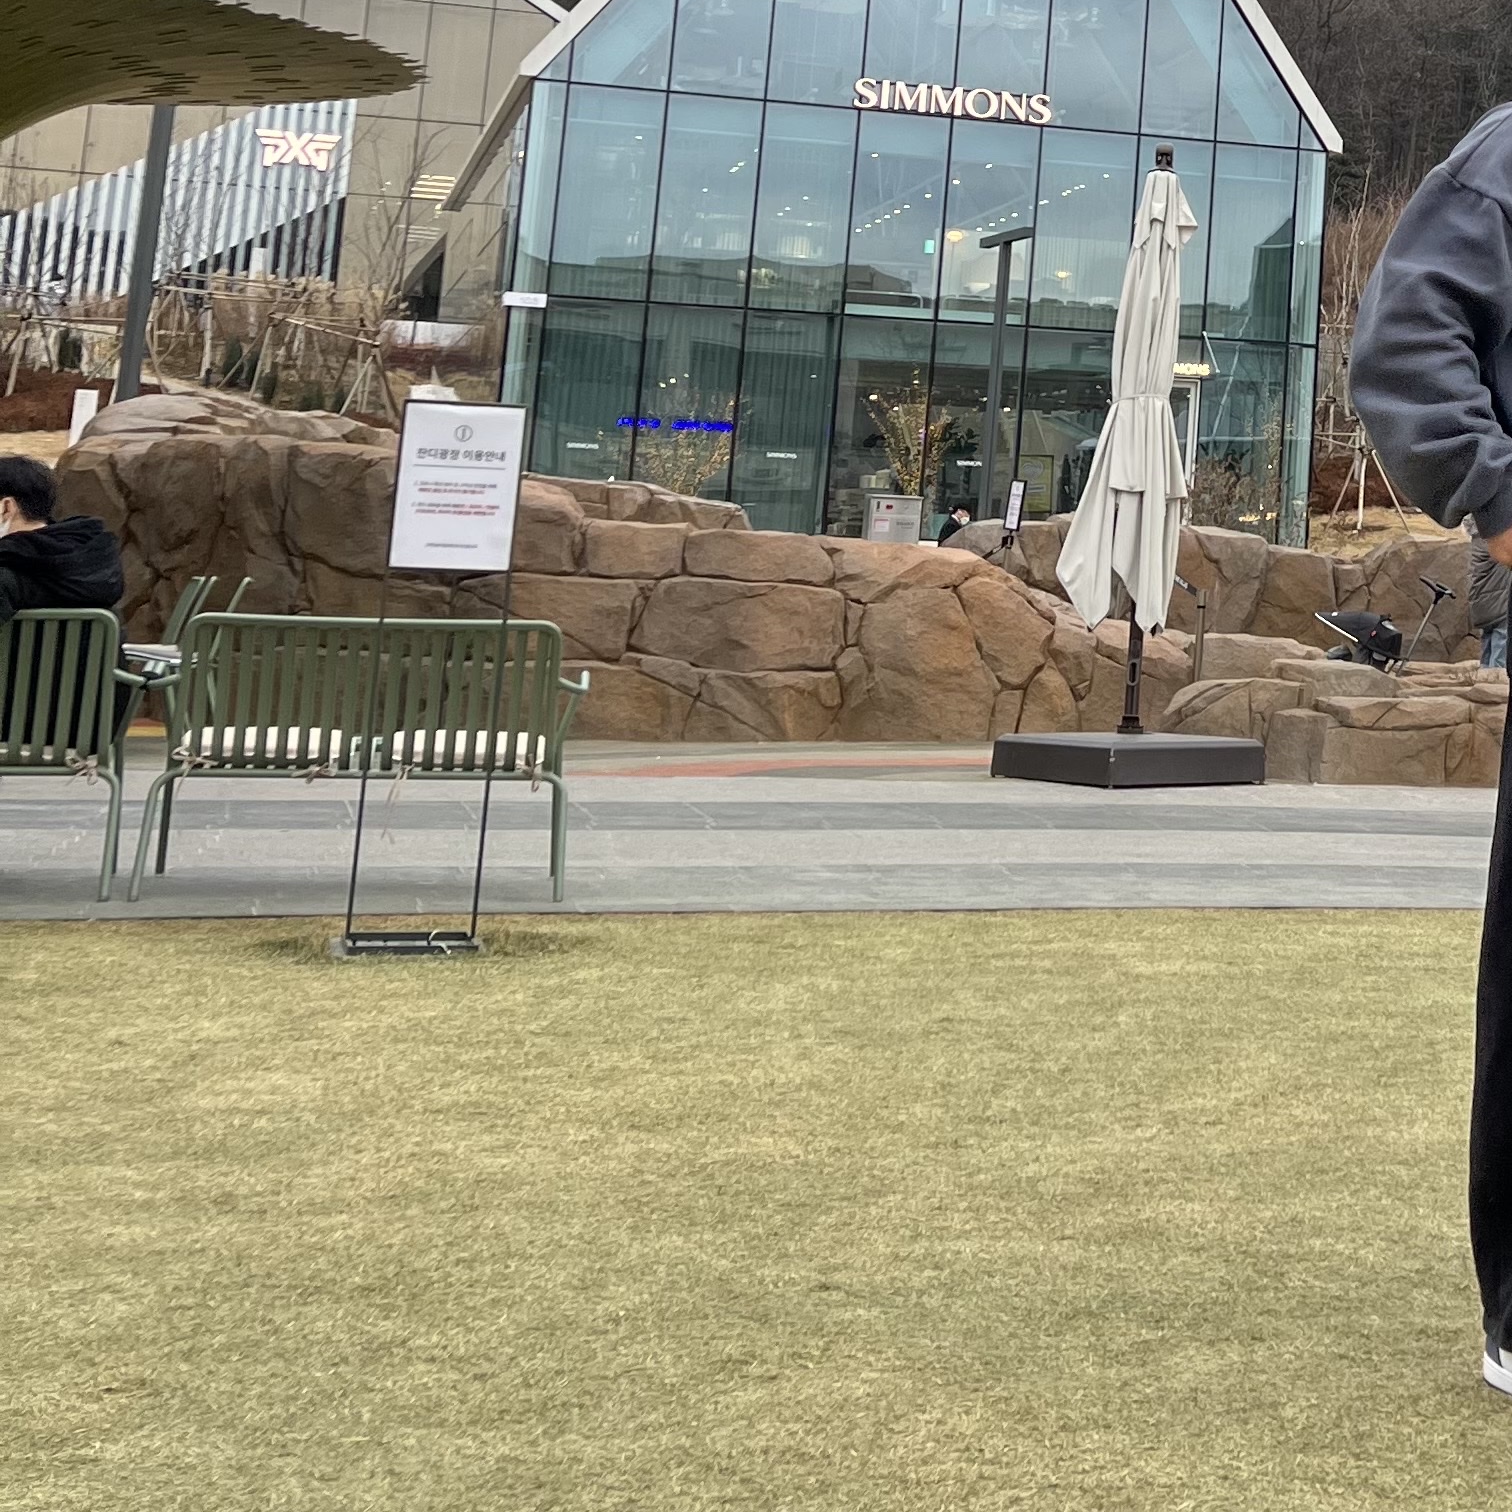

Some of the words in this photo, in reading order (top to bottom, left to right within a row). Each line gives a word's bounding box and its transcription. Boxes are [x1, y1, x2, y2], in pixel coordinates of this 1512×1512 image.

[853, 77, 1052, 125] SIMMONS
[255, 128, 342, 172] PXG
[1173, 362, 1210, 376] MONS
[462, 449, 507, 463] 이용안내
